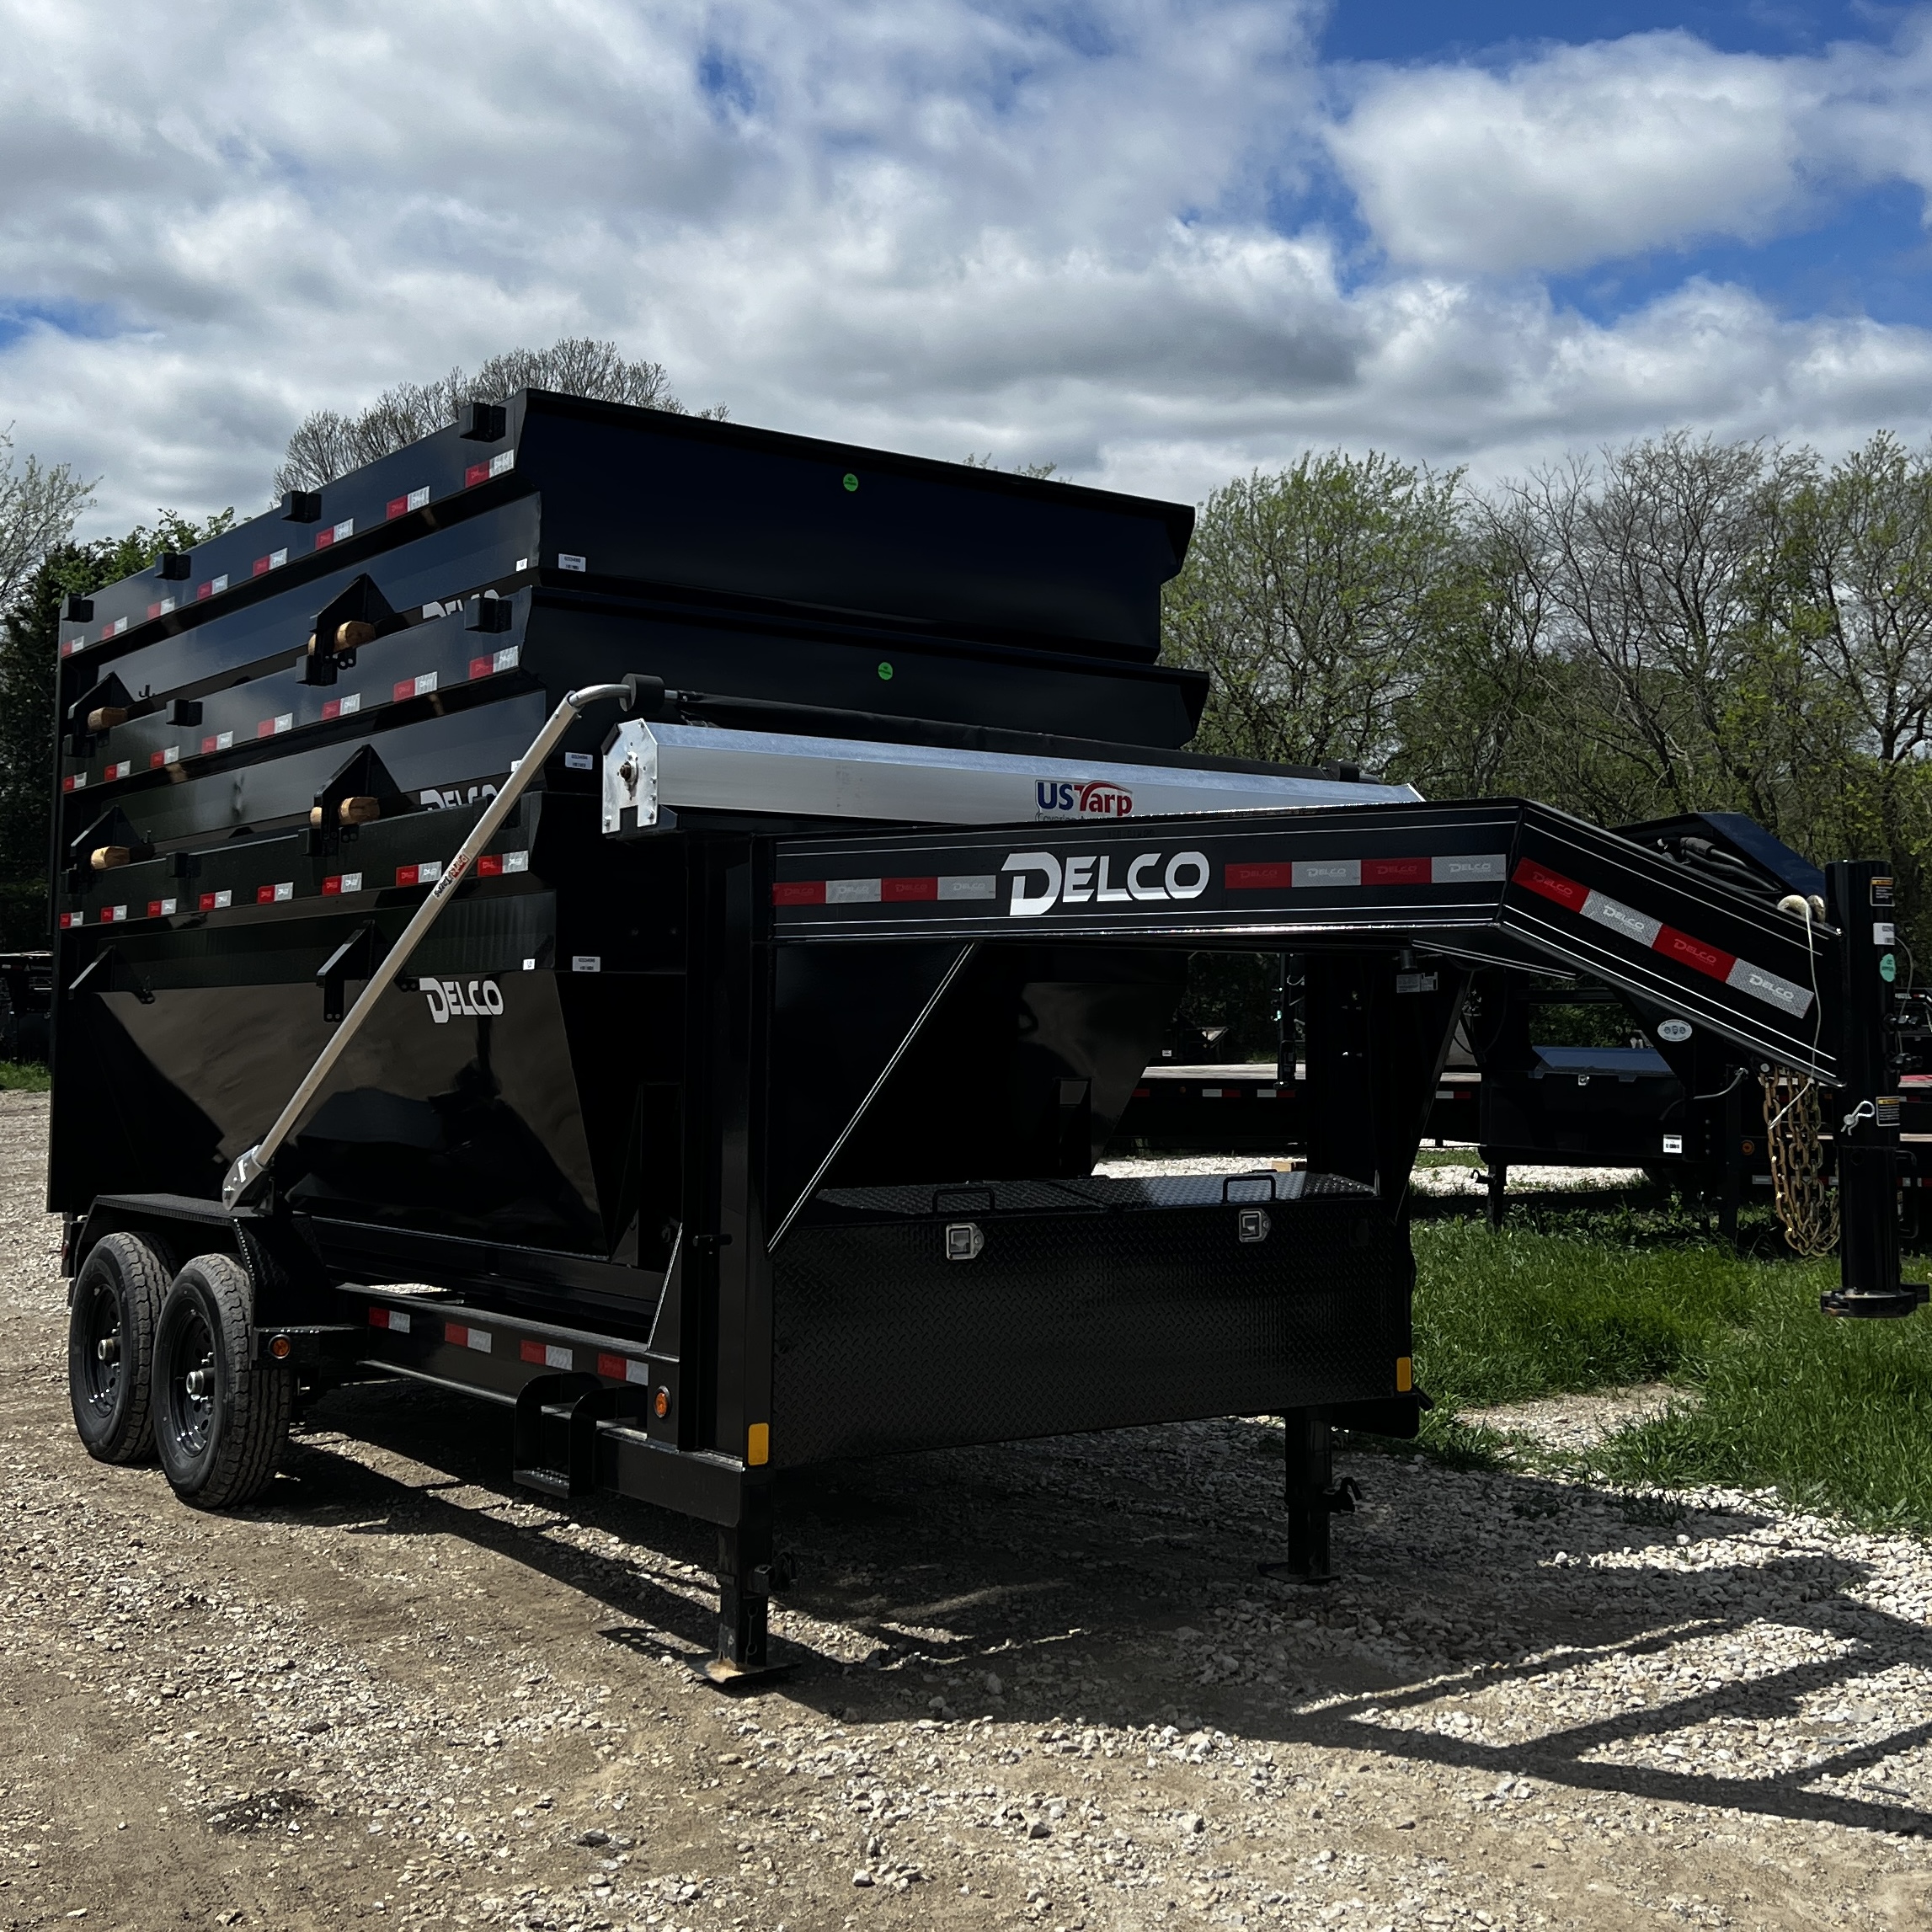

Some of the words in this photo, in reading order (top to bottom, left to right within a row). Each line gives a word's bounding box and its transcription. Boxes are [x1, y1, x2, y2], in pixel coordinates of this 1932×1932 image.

[1001, 851, 1210, 915] DELCO
[1533, 871, 1573, 895] DELCO
[1603, 904, 1645, 931] DELCO
[1673, 938, 1717, 963] DELCO
[419, 977, 504, 1023] DELCO
[1748, 974, 1795, 1000] DELCO
